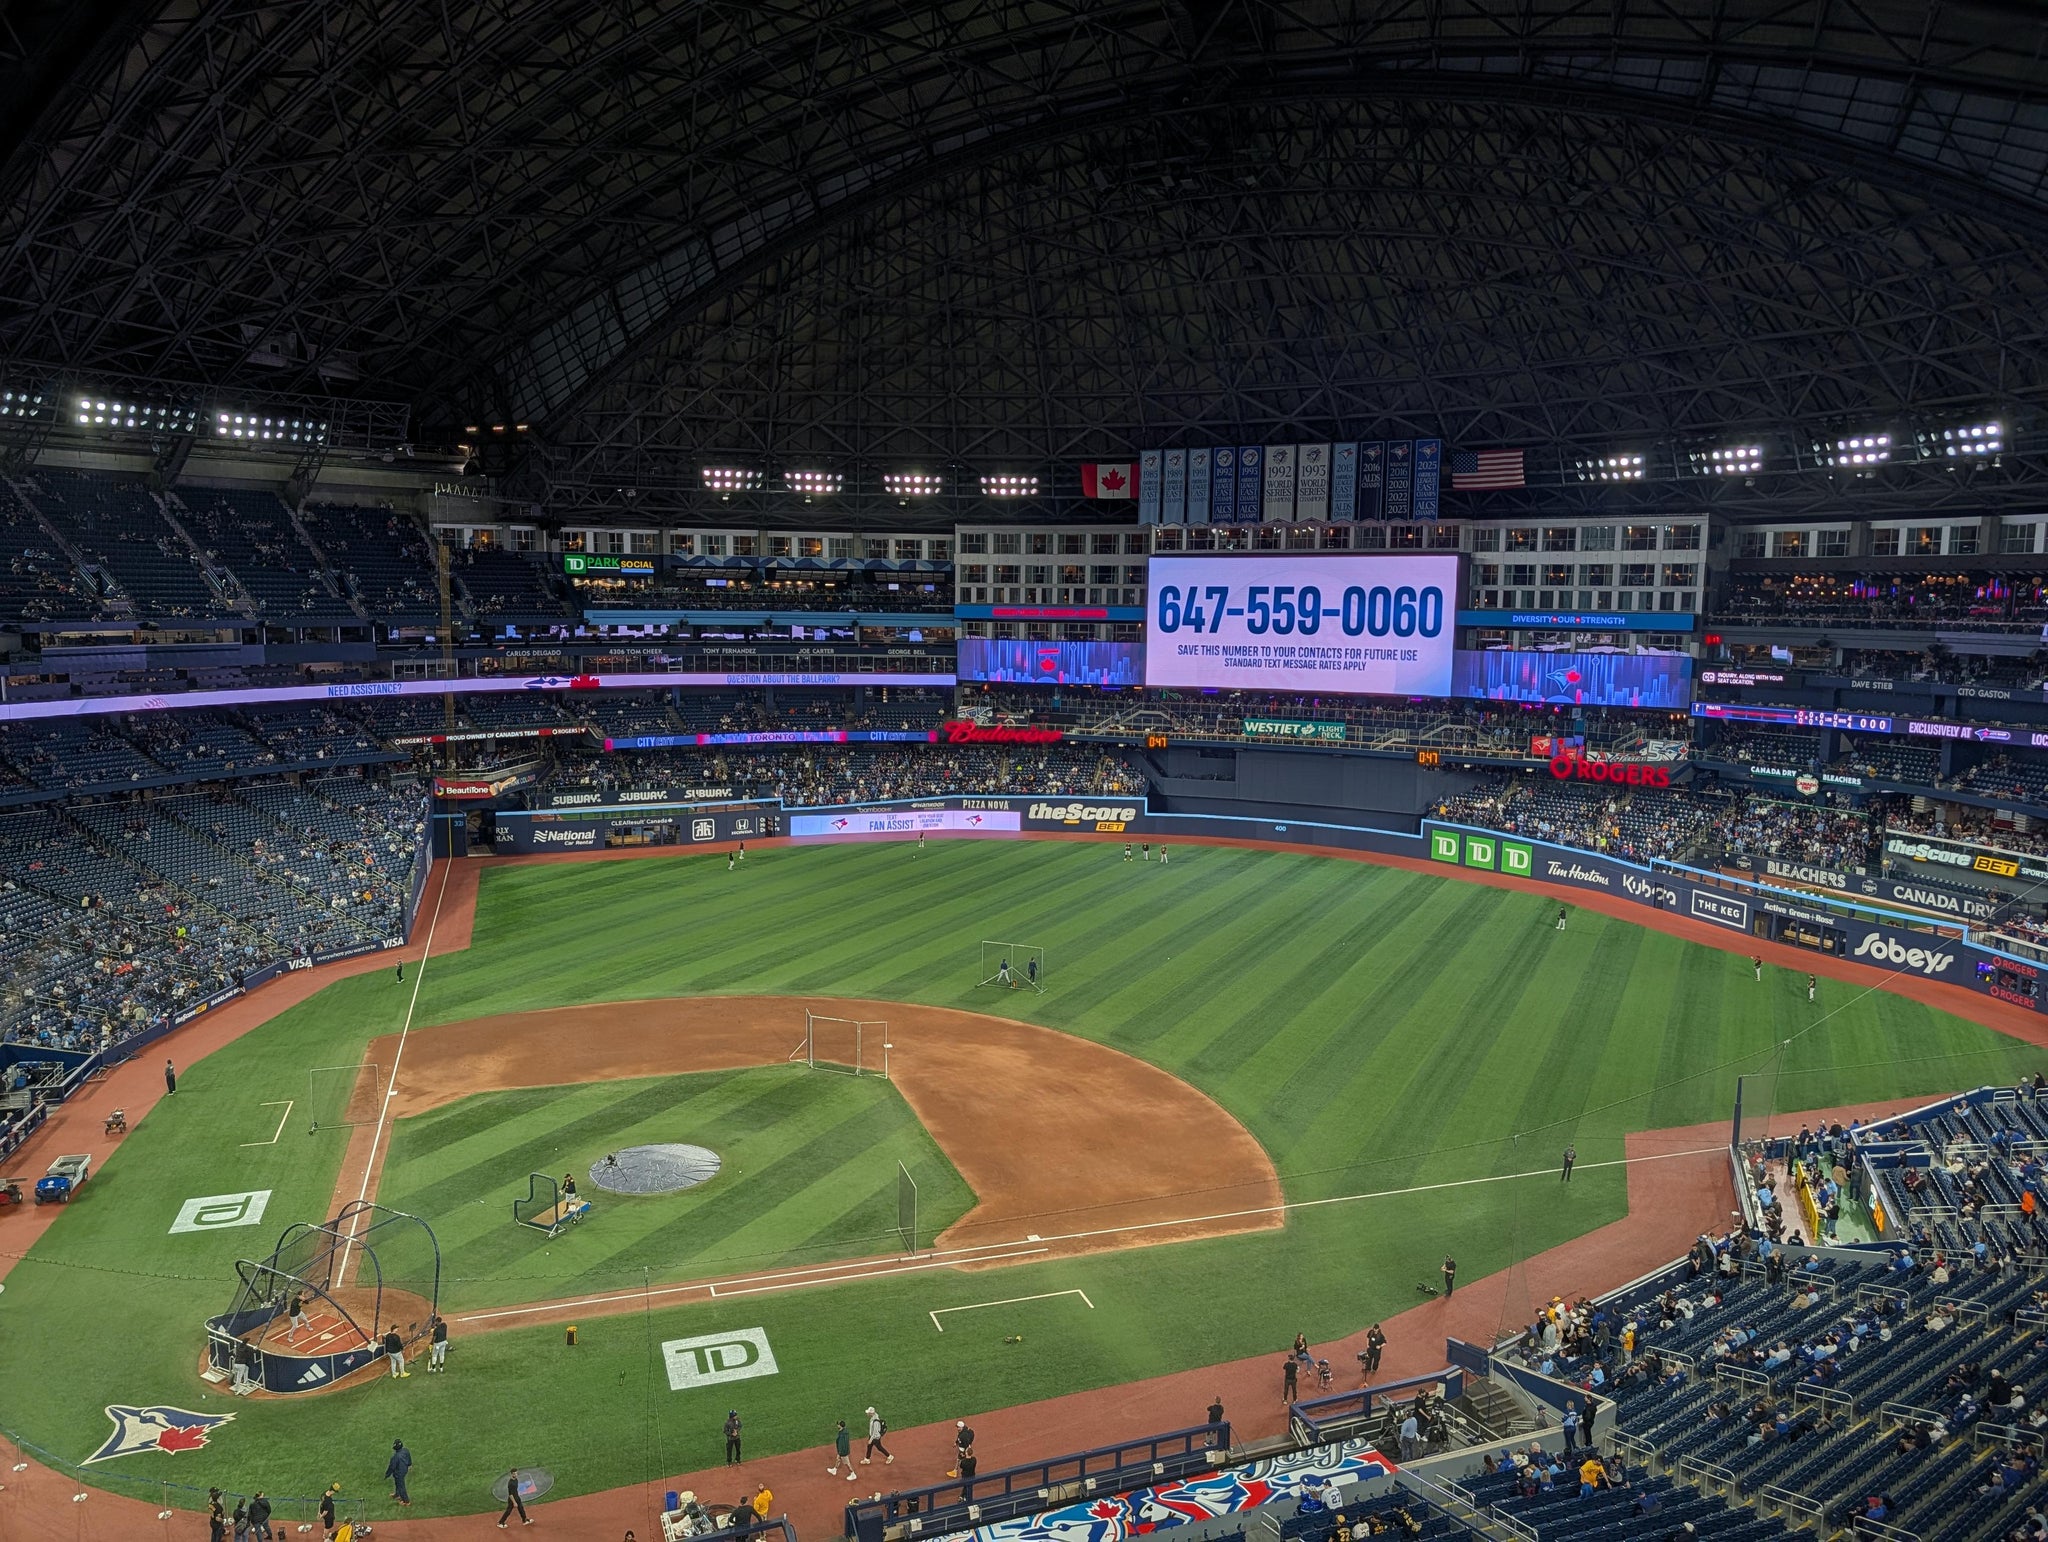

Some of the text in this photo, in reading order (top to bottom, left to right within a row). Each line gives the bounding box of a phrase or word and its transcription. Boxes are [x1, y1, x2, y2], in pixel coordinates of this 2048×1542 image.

[1302, 465, 1326, 477] 1993
[1363, 463, 1380, 472] 2016
[1418, 461, 1437, 470] 2025
[1216, 468, 1232, 476] 1992
[1268, 466, 1292, 478] 1992
[1362, 474, 1381, 482] ALDS
[1390, 468, 1408, 476] 2016
[1267, 480, 1292, 488] WORLD
[1389, 481, 1408, 489] 2020
[1388, 493, 1407, 501] 2022
[1335, 503, 1352, 511] ALDS
[1388, 505, 1407, 513] 2023
[1416, 501, 1435, 509] ALCS
[567, 558, 654, 570] TD PARK SOCIAL
[1158, 585, 1443, 638] 647-559-0060
[1513, 615, 1625, 625] DIVERSITY OUR STRENGTH
[1178, 645, 1418, 661] SAVE THIS NUMBER TO YOUR CONTACTS FOR FUTURE USE
[1224, 658, 1366, 671] STANDARD TEXT MESSAGE RATES APPLY
[727, 675, 840, 683] QUESTION ABOUT THE BALLPARK?
[1851, 680, 1893, 690] DAVE STIEB
[328, 684, 402, 696] NEED ASSISTANCE?
[1958, 688, 2010, 699] CITO GASTON
[1245, 722, 1300, 735] WESTJET
[1860, 719, 1886, 729] 0 0 0
[1909, 722, 1972, 738] EXCLUSIVELY AT
[870, 732, 887, 741] CITY
[944, 721, 1063, 744] Budweiser
[637, 737, 655, 747] CITY
[1419, 752, 1438, 763] 0:47
[1577, 760, 1670, 786] ROGERS
[1750, 766, 1797, 777] CANADA DRY
[1822, 774, 1861, 785] BLEACHERS
[618, 791, 668, 802] SUBWAY
[684, 788, 733, 798] SUBWAY
[552, 794, 601, 805] SUBWAY
[963, 800, 1009, 810] PIZZA NOVA
[1028, 803, 1136, 821] theScore
[870, 821, 884, 830] FAN
[887, 820, 914, 830] ASSIST
[547, 830, 595, 841] National
[1435, 836, 1456, 856] TD
[1469, 842, 1491, 862] TD
[1505, 848, 1529, 868] TD
[1888, 840, 1972, 866] theScore
[1976, 859, 2015, 873] BET
[1548, 861, 1609, 886] Tim Hortons
[1767, 861, 1846, 888] BLEACHERS
[1623, 874, 1676, 905] Kubota
[1894, 886, 1959, 912] CANADA
[1964, 900, 1996, 919] DRY
[1699, 900, 1740, 918] THE KEG
[1764, 903, 1835, 925] Active Green+Ross
[381, 937, 404, 949] VISA
[1854, 932, 1954, 974] Sobeys
[287, 957, 313, 970] VISA
[317, 951, 344, 961] everywhere
[2002, 960, 2037, 978] ROGERS
[210, 991, 233, 1006] BASELINE
[2000, 990, 2034, 1008] ROGERS
[675, 1340, 759, 1375] TD
[1331, 1493, 1341, 1504] 27
